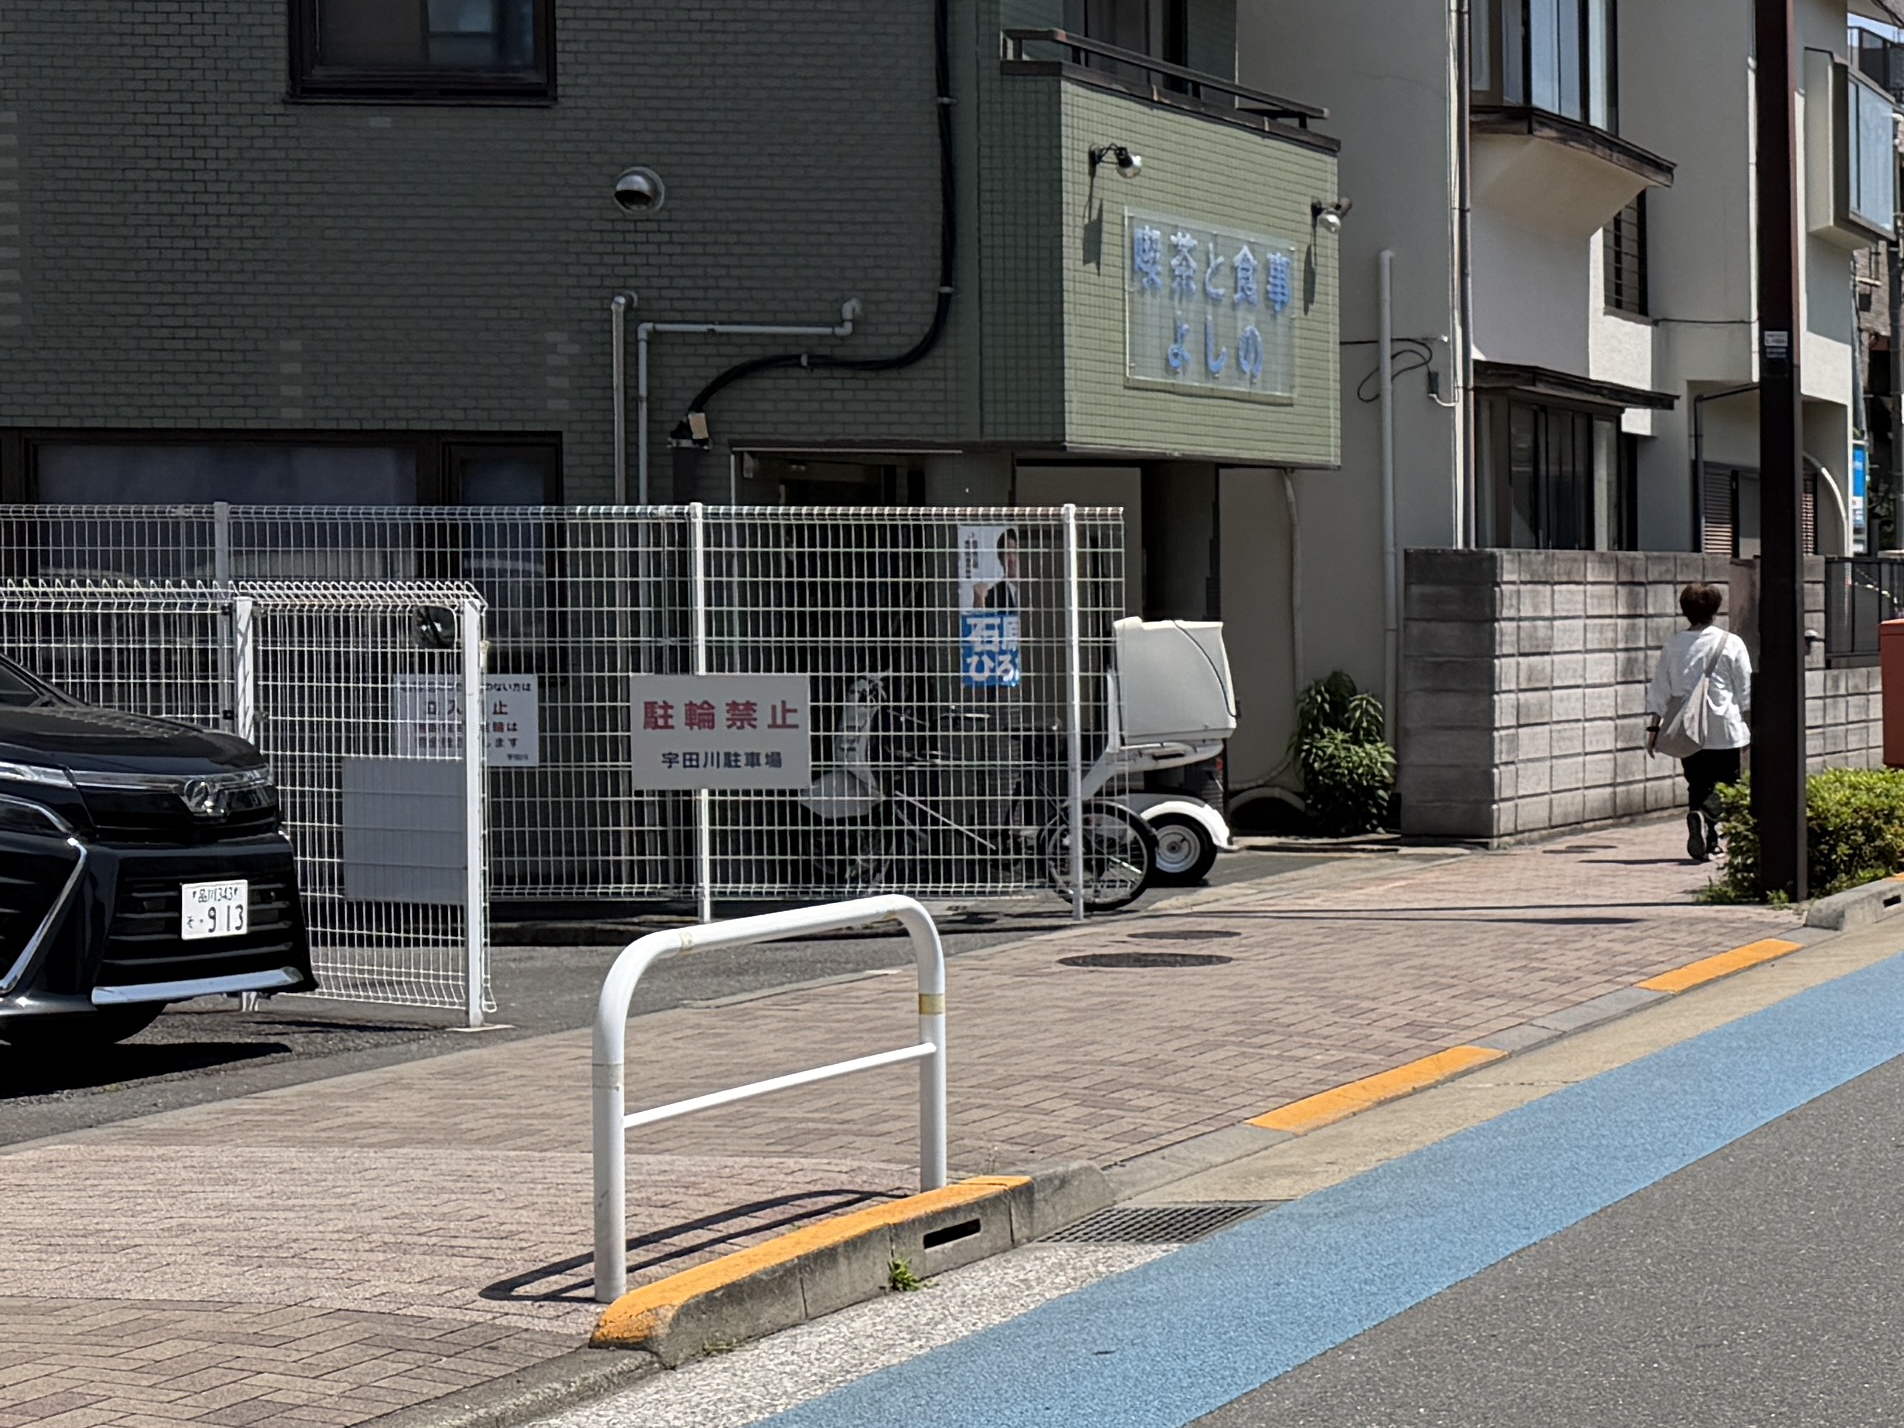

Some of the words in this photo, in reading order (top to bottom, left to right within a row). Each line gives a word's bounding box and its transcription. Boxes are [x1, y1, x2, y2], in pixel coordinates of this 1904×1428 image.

[1134, 226, 1292, 313] 喫茶と食事
[1168, 311, 1264, 384] よしの
[643, 700, 799, 730] 駐輪禁止
[661, 751, 783, 769] 宇田川駐車場
